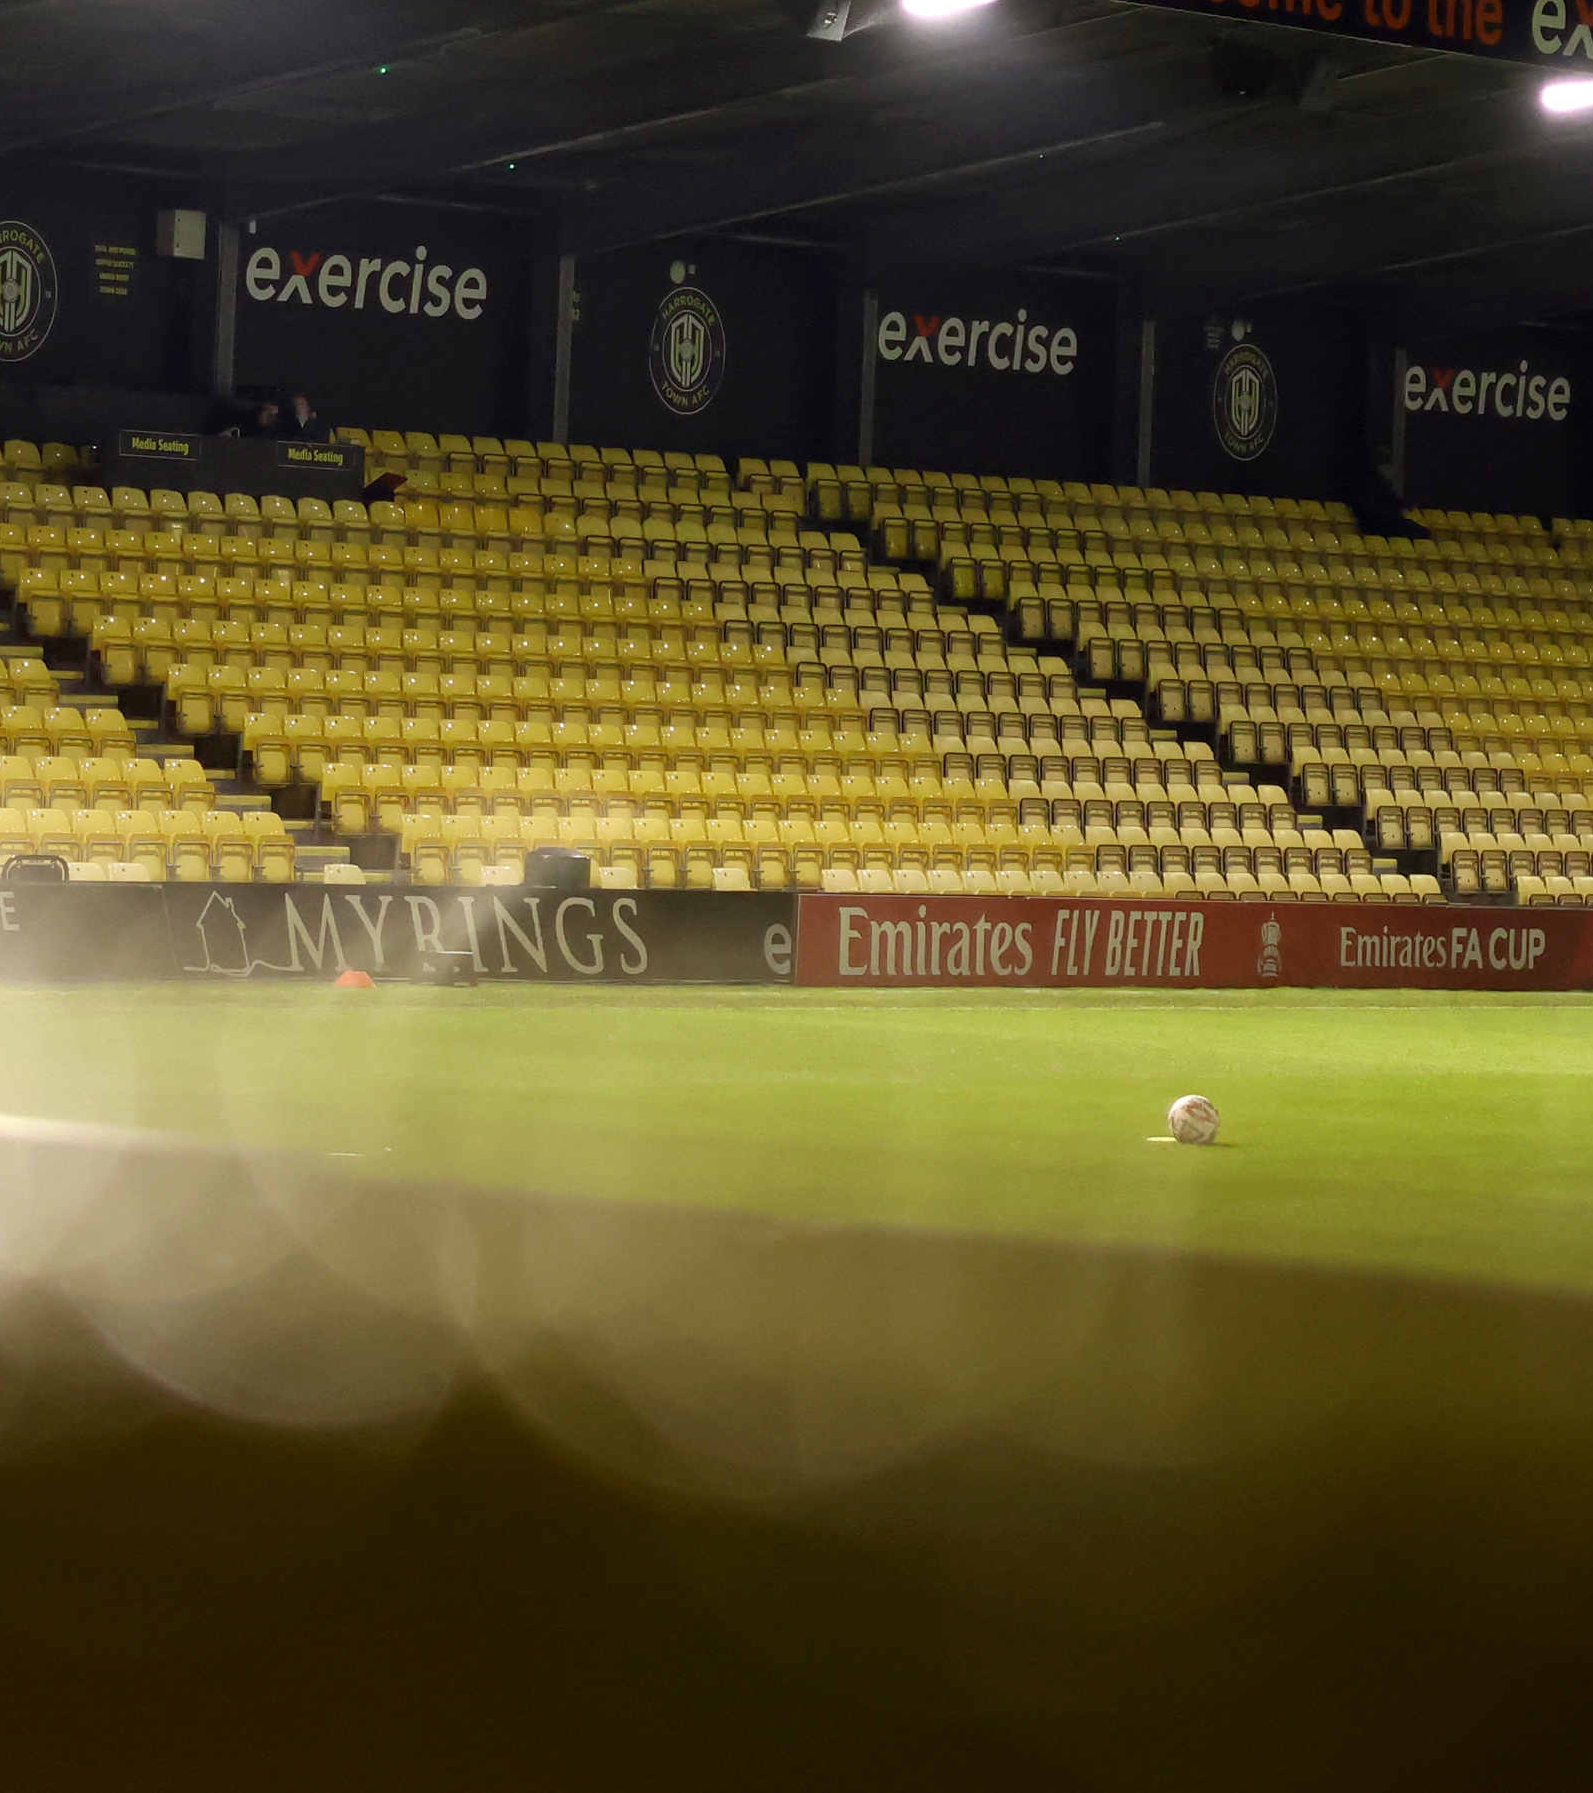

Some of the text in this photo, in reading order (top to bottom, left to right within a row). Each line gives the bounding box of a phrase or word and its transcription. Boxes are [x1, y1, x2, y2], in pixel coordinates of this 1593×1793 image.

[245, 245, 488, 320] exercise
[662, 294, 717, 327] HARROGATE
[16, 328, 40, 352] AFC
[878, 308, 1079, 376] exercise
[661, 381, 710, 407] TOWN AFC
[1404, 360, 1571, 422] exercise
[131, 436, 190, 456] Media Seating
[287, 447, 344, 467] Media Seating
[285, 892, 648, 975] MYRINGS
[838, 904, 1205, 977] Emirates FLY BETTER
[1340, 925, 1546, 970] Emirates FA CUP
